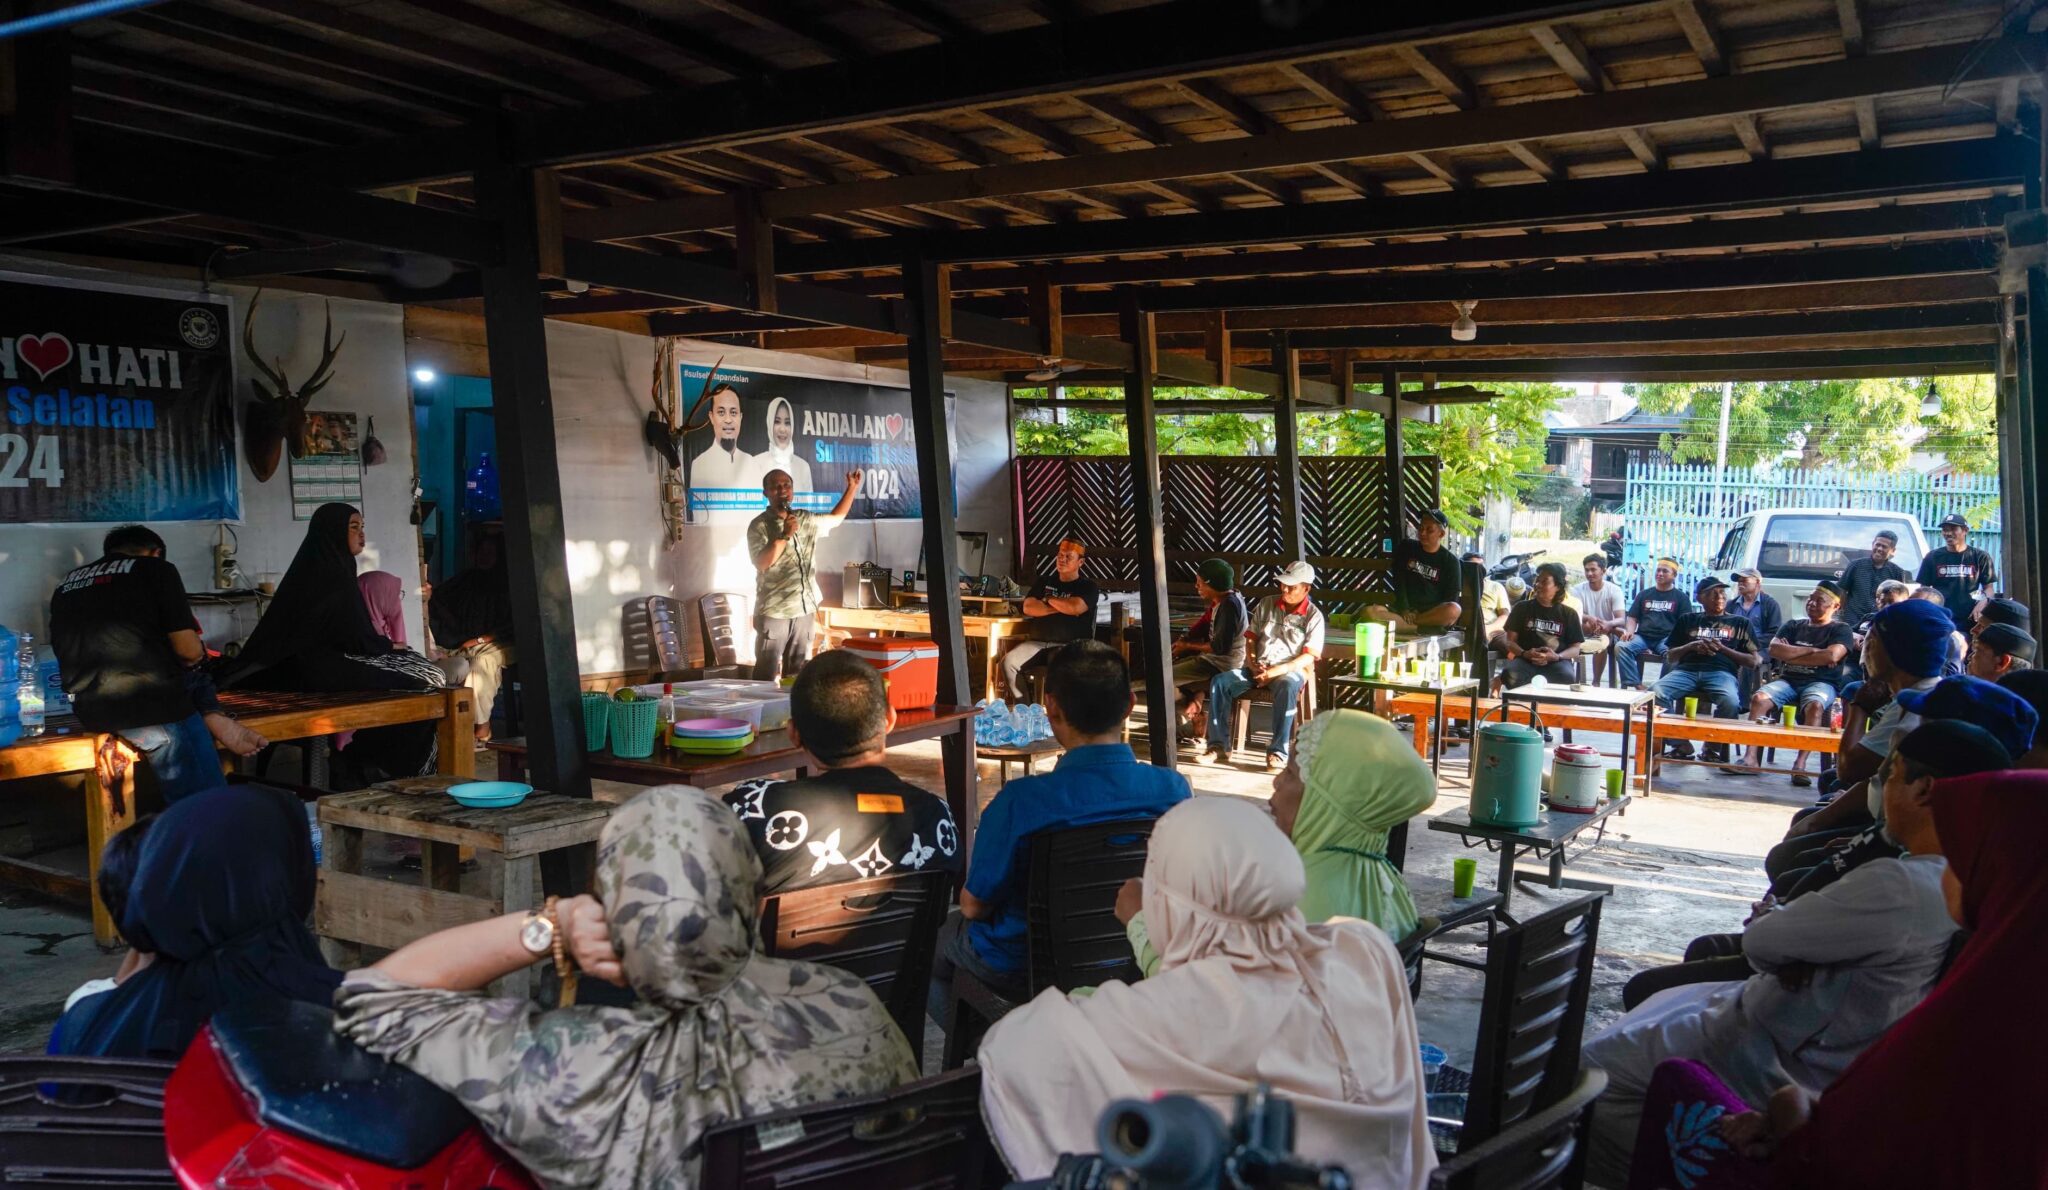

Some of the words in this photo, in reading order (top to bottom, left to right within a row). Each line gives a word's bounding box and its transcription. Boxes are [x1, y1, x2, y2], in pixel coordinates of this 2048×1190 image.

[77, 343, 182, 389] HATI
[7, 386, 155, 429] Selatan
[802, 410, 886, 440] ANDALAN
[815, 439, 879, 464] Sulawesi
[854, 468, 900, 500] 2024
